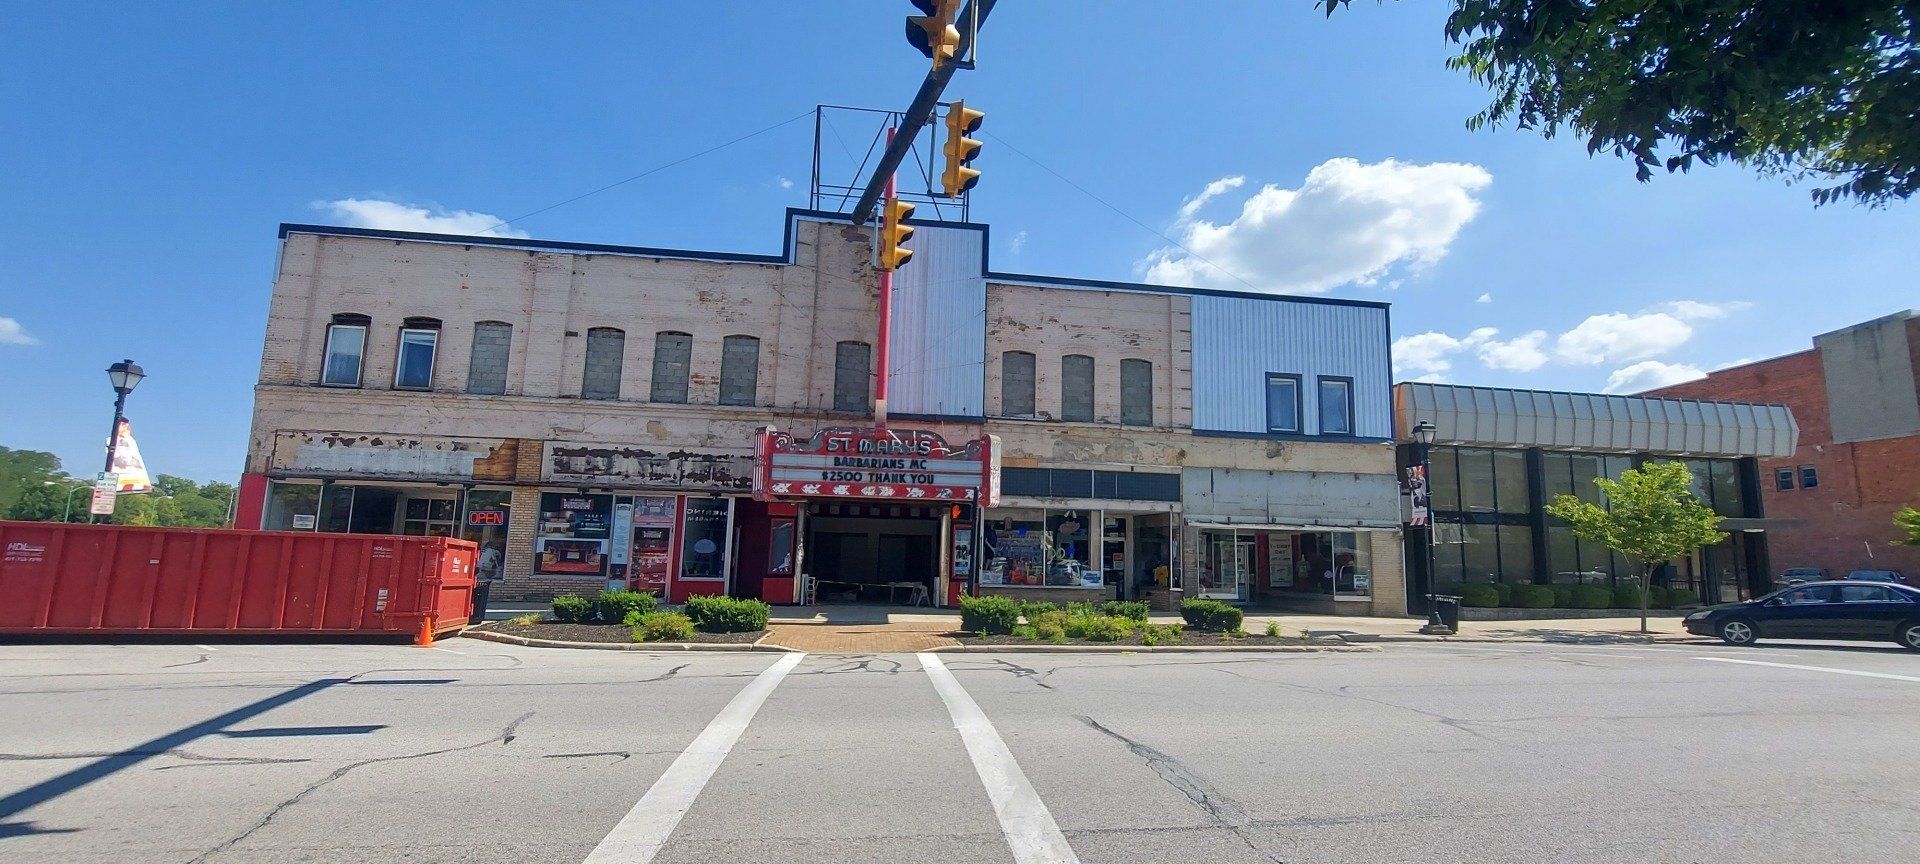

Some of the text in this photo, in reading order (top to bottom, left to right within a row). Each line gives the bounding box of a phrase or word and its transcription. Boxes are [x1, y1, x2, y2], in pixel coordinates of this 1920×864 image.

[858, 438, 932, 455] MARYS
[833, 456, 927, 470] BARBARIANS MC
[822, 471, 935, 485] $2500 THANK YOU
[471, 512, 502, 524] OPEN
